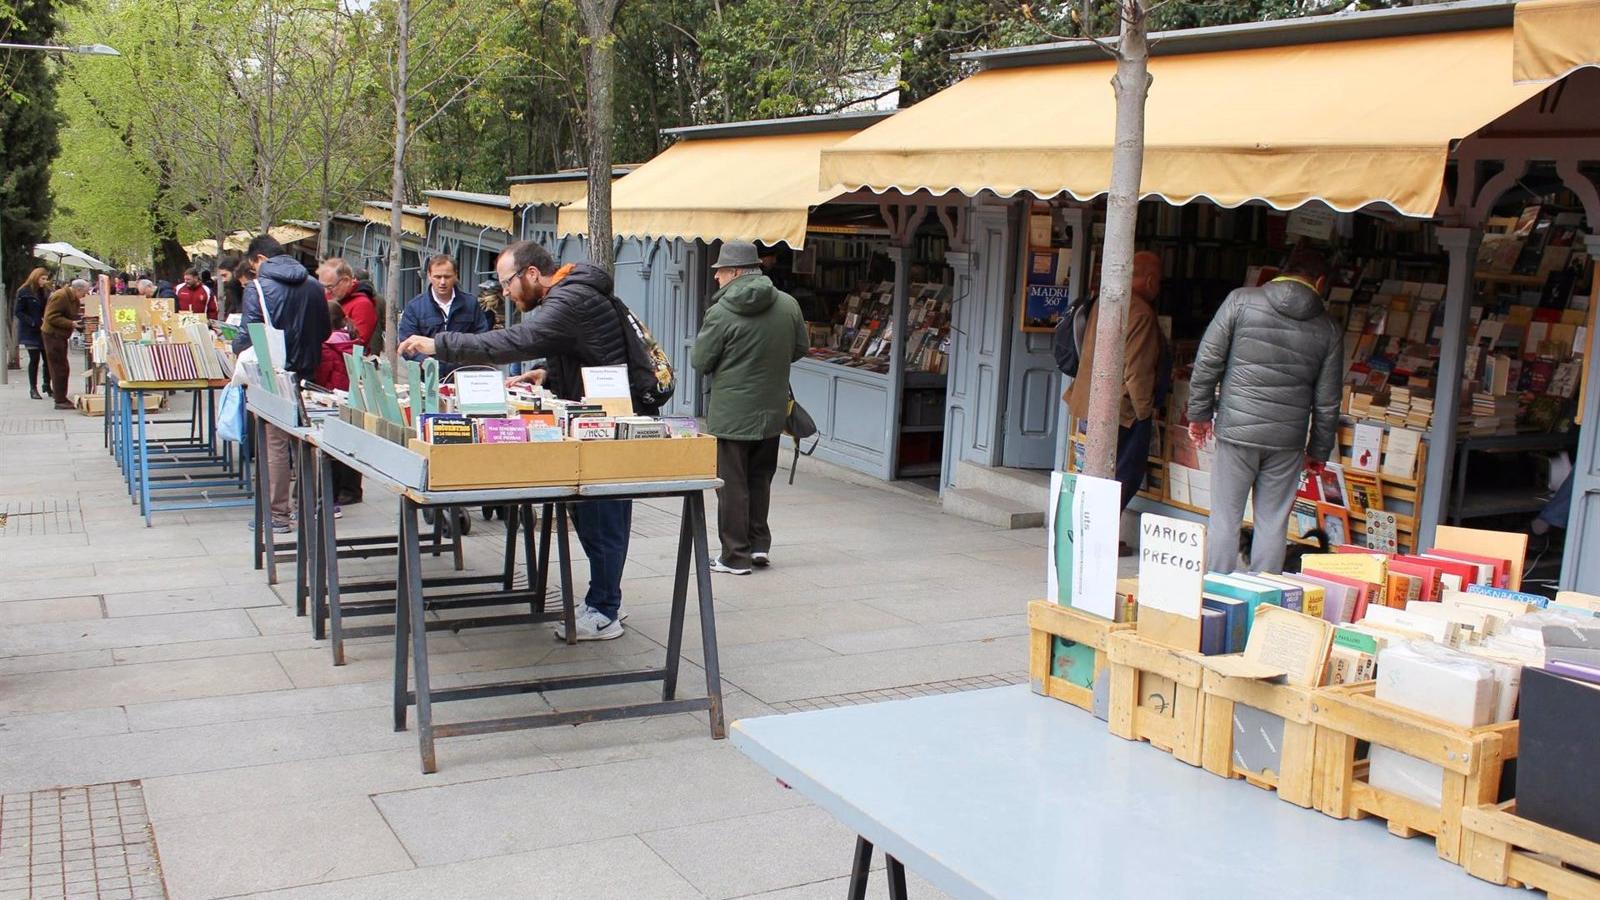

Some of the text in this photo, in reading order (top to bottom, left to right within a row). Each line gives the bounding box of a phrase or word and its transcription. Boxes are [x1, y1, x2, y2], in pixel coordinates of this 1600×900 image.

[1031, 287, 1068, 297] MADRI
[1143, 523, 1198, 547] VARIOS
[1143, 548, 1201, 572] PRECIOS
